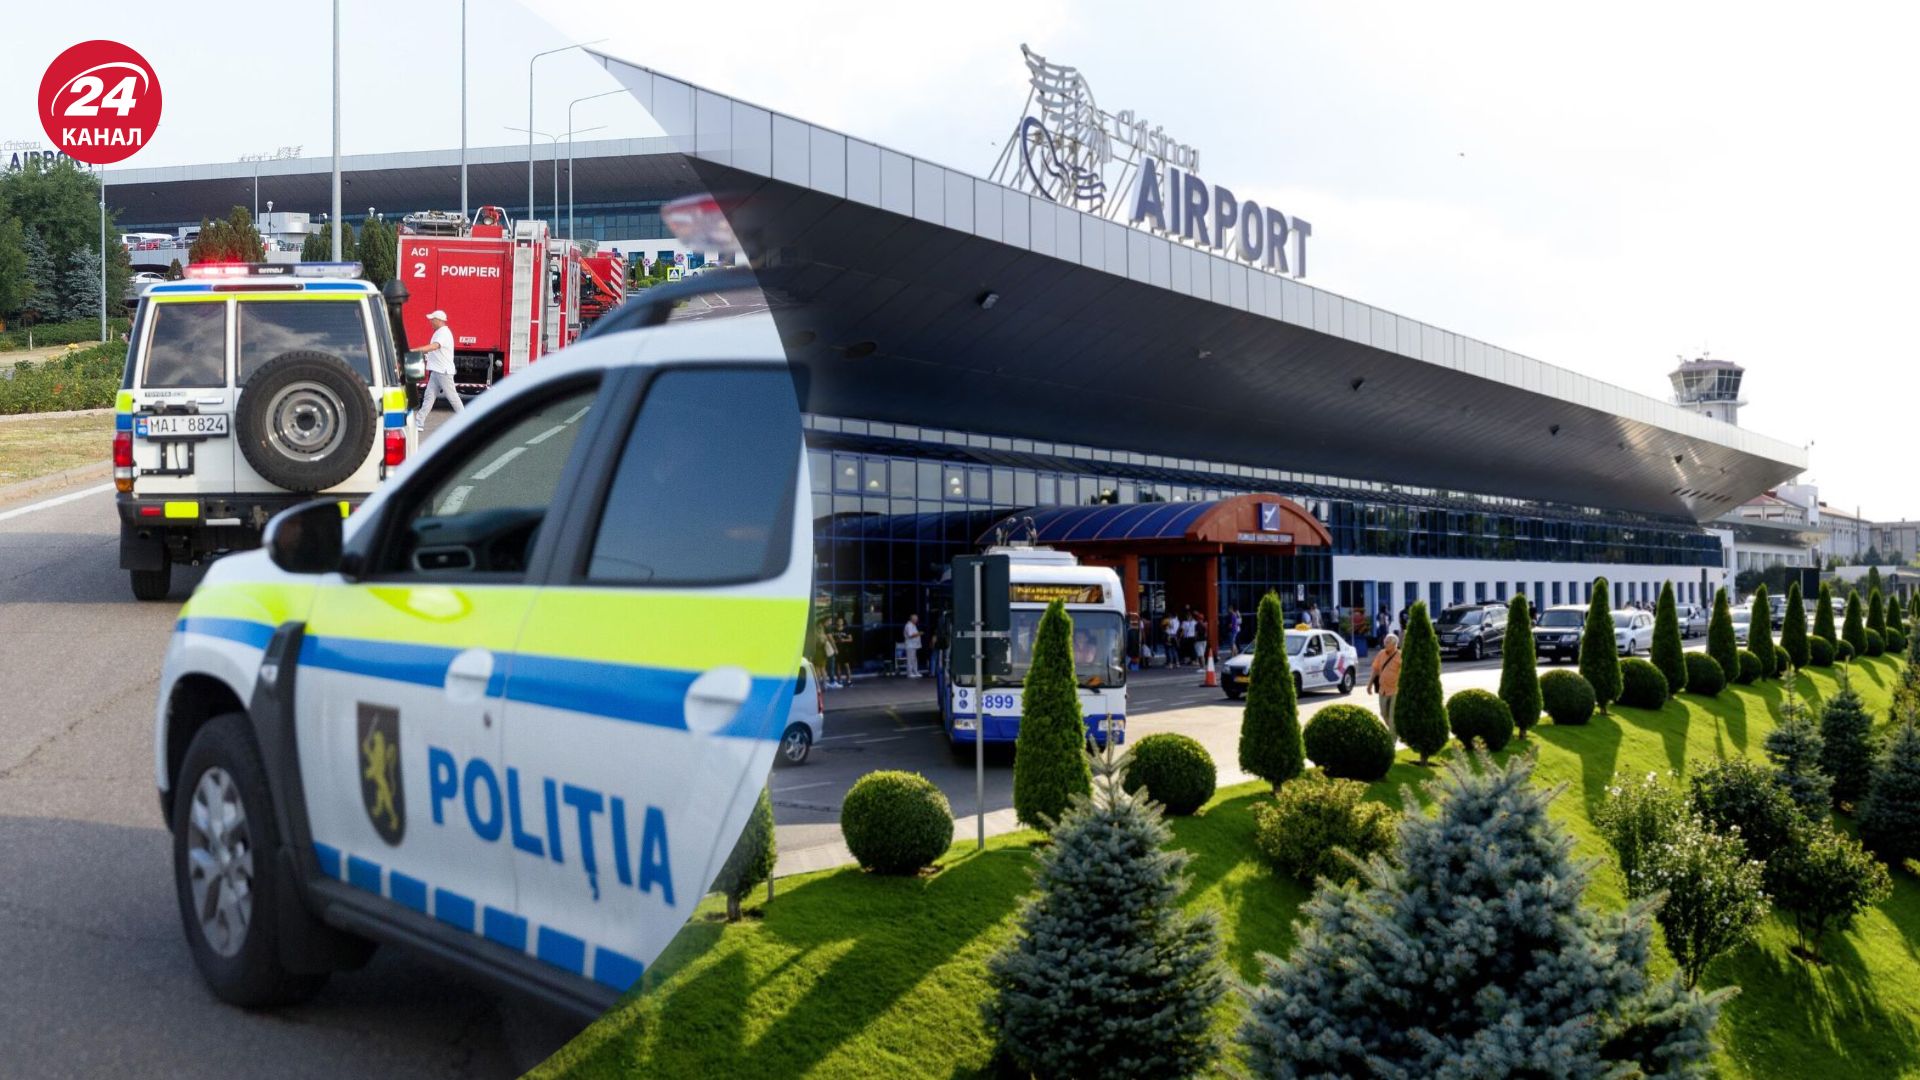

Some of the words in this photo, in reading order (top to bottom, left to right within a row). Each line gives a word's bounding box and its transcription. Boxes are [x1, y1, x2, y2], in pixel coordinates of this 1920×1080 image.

[1129, 156, 1312, 279] AIRPORT
[411, 247, 429, 257] ACI
[413, 262, 426, 278] 2
[441, 265, 500, 278] POMPIERI
[151, 418, 178, 433] MAI
[188, 417, 224, 432] 8824
[428, 744, 675, 907] POLIȚIA
